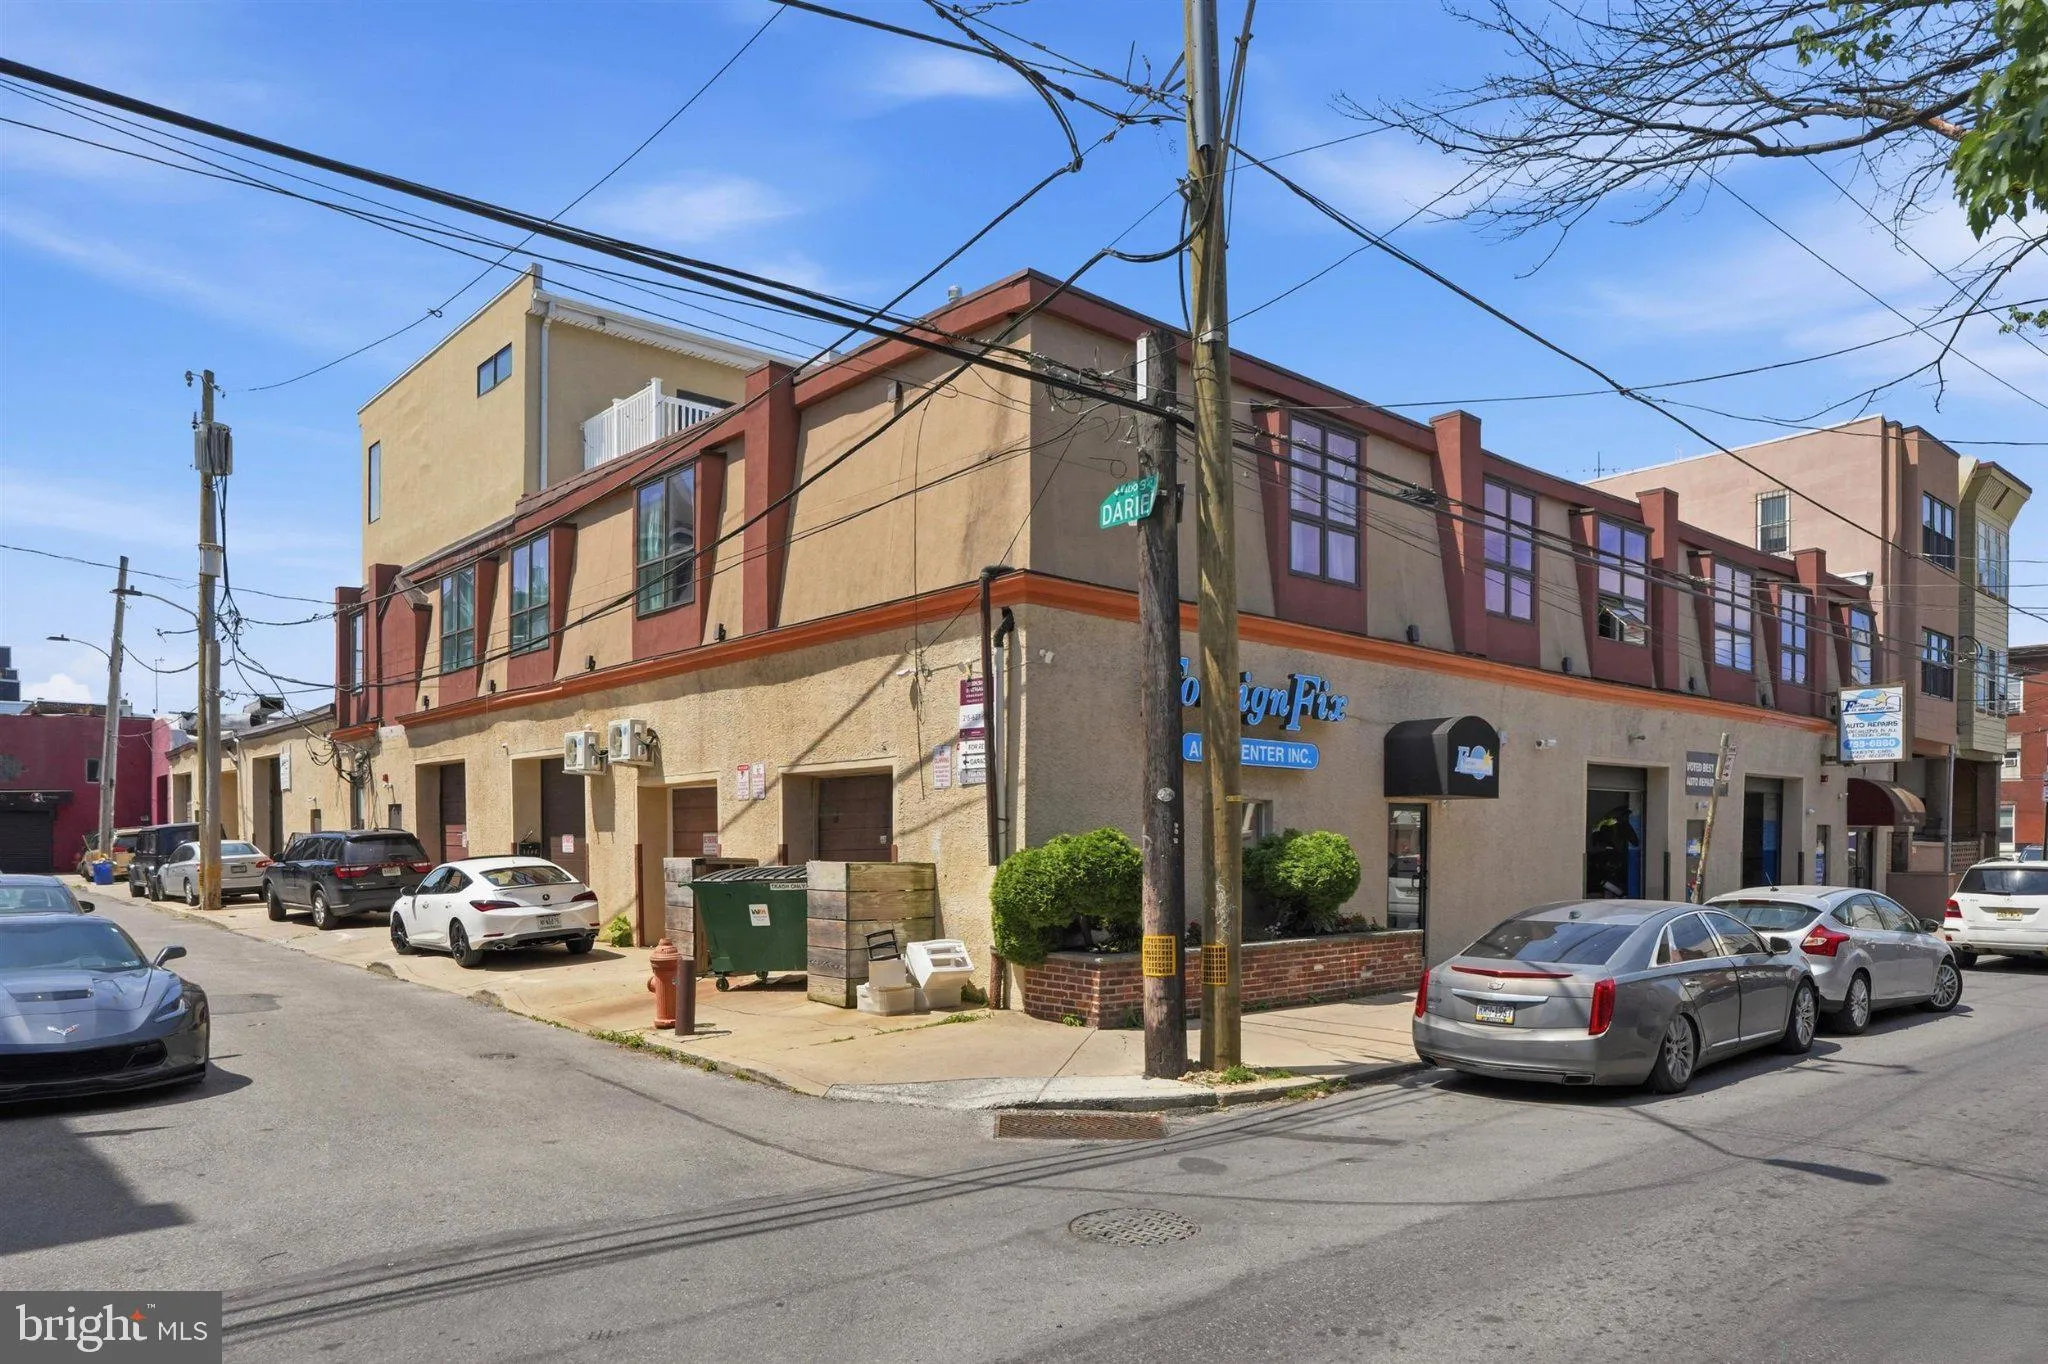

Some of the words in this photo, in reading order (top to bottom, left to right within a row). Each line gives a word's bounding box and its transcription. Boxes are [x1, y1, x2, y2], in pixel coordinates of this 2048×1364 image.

[1241, 744, 1285, 762] ENTER
[1287, 748, 1313, 764] INC.
[1686, 761, 1702, 772] VOTED
[1702, 762, 1715, 773] BEST
[1686, 776, 1699, 786] AUTO
[1698, 777, 1715, 787] REPAIR
